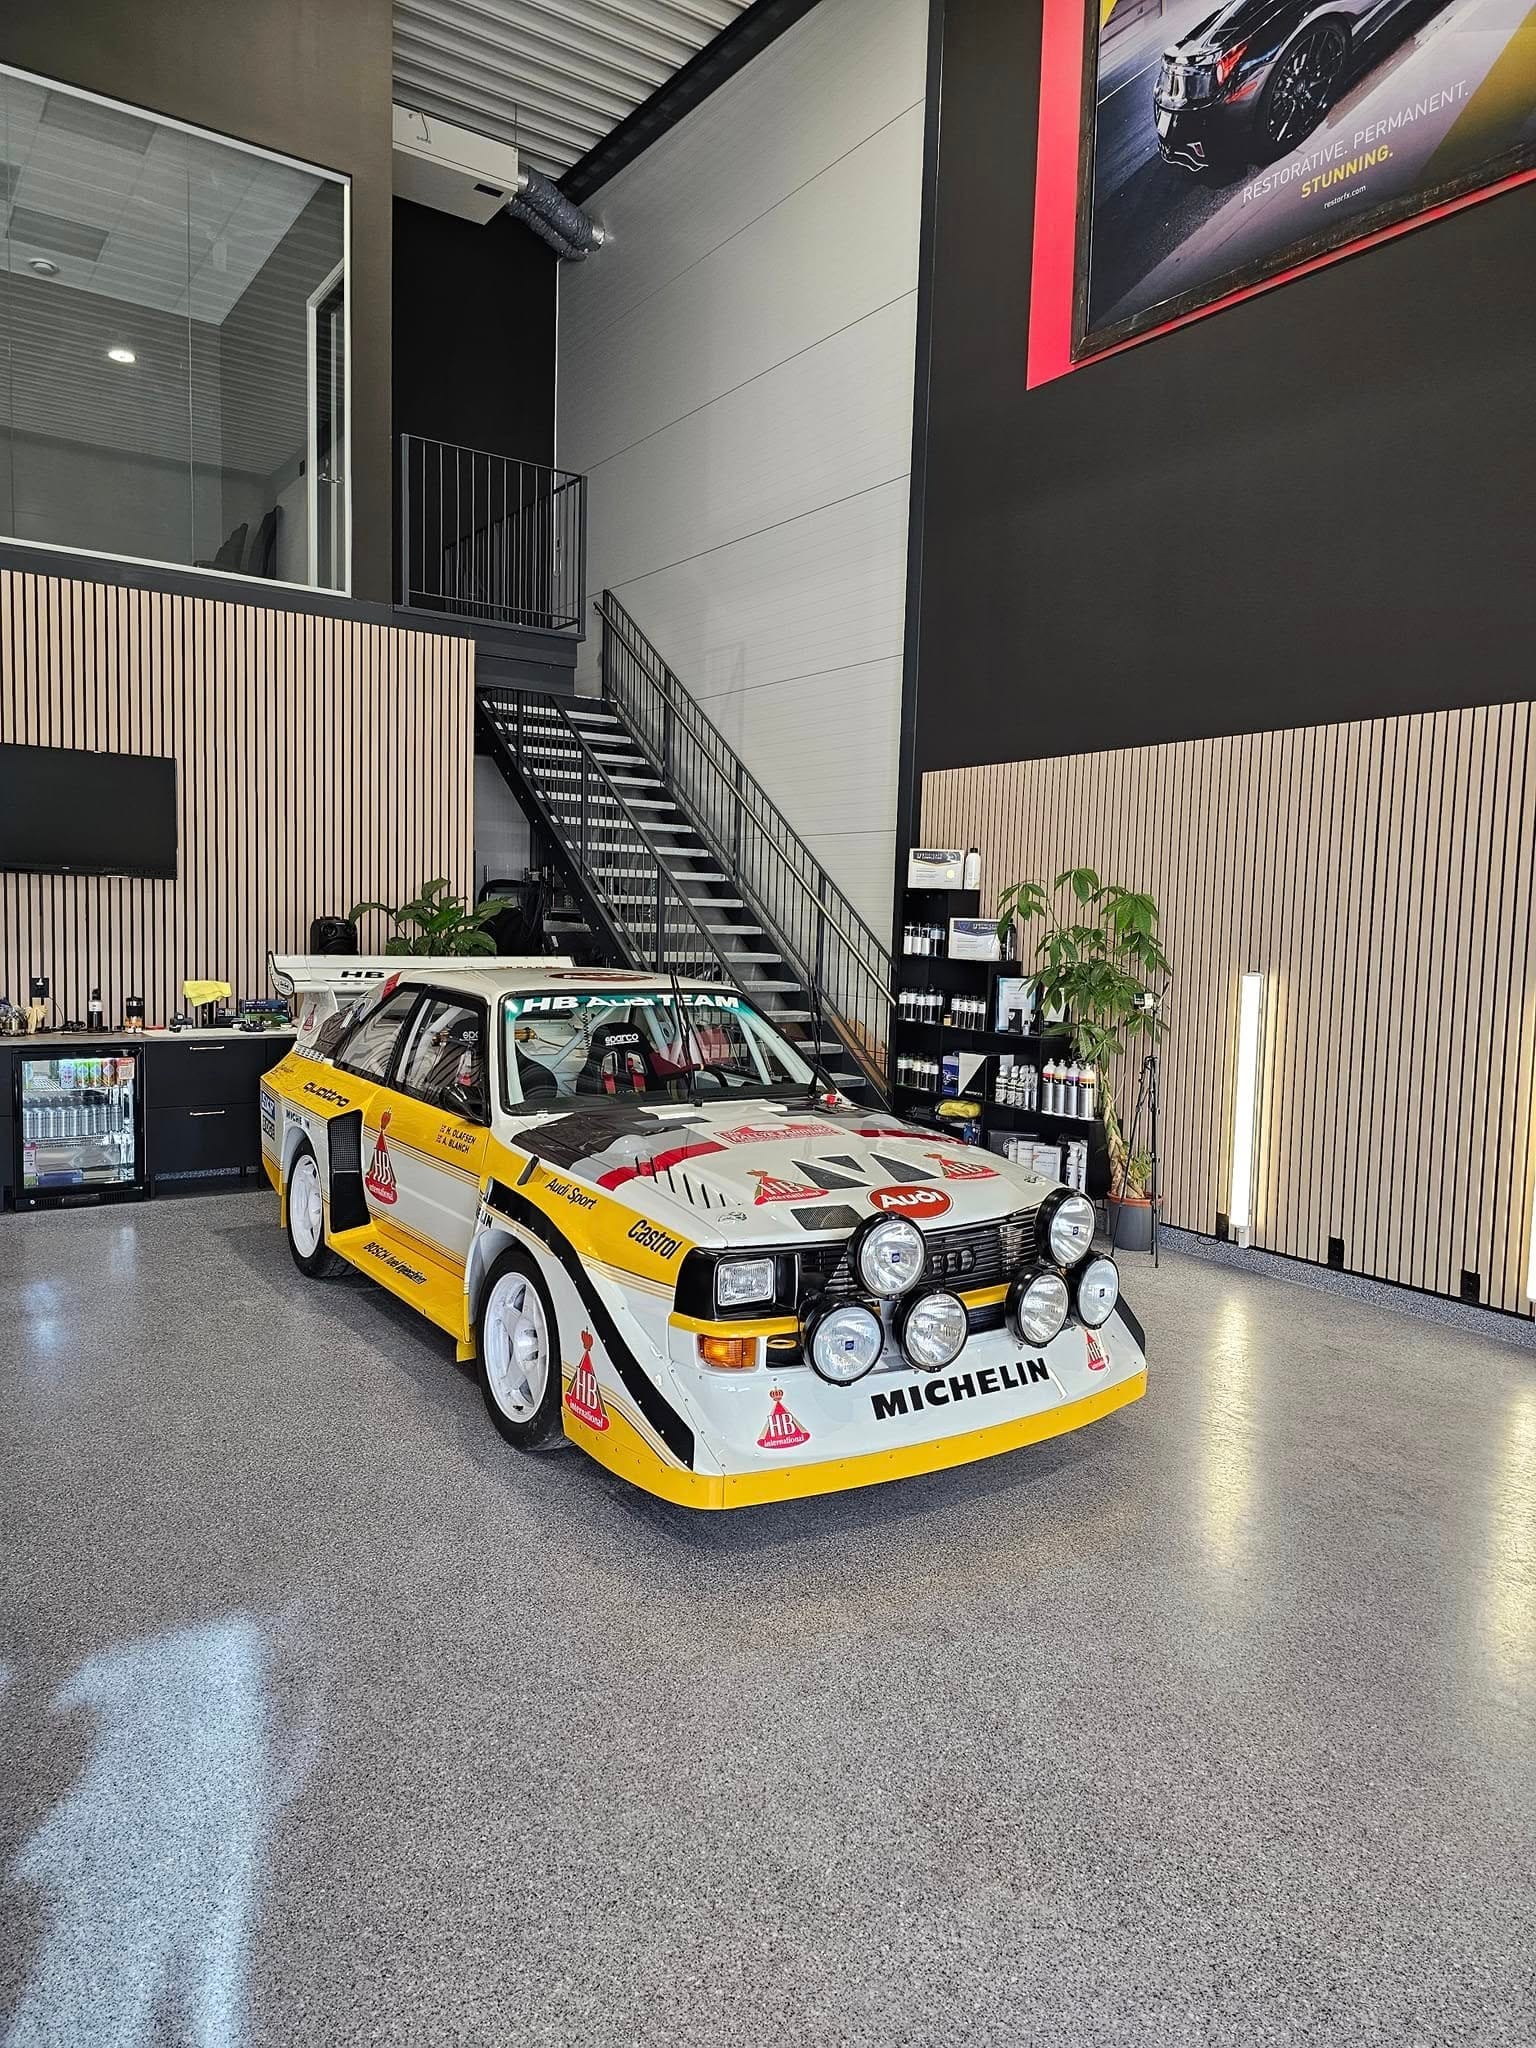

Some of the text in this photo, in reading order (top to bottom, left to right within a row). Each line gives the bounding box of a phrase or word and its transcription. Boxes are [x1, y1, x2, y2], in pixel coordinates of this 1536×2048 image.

[1243, 80, 1468, 203] RESTORATIVE. PERMANENT.
[1301, 144, 1393, 199] STUNNING.
[1323, 184, 1366, 209] restorfx.com
[522, 994, 739, 1013] HB Audi TEAM
[605, 1033, 639, 1045] sparco
[303, 1082, 350, 1107] quattro
[545, 1178, 598, 1209] Audi Sport
[760, 1180, 804, 1195] HB
[879, 1189, 944, 1209] Audi
[363, 1242, 392, 1260] BOSCH
[628, 1219, 683, 1260] Castrol
[576, 1369, 598, 1410] HB
[871, 1357, 1050, 1420] MICHELIN
[569, 1399, 604, 1428] international
[767, 1413, 795, 1438] HB
[764, 1434, 805, 1448] international
